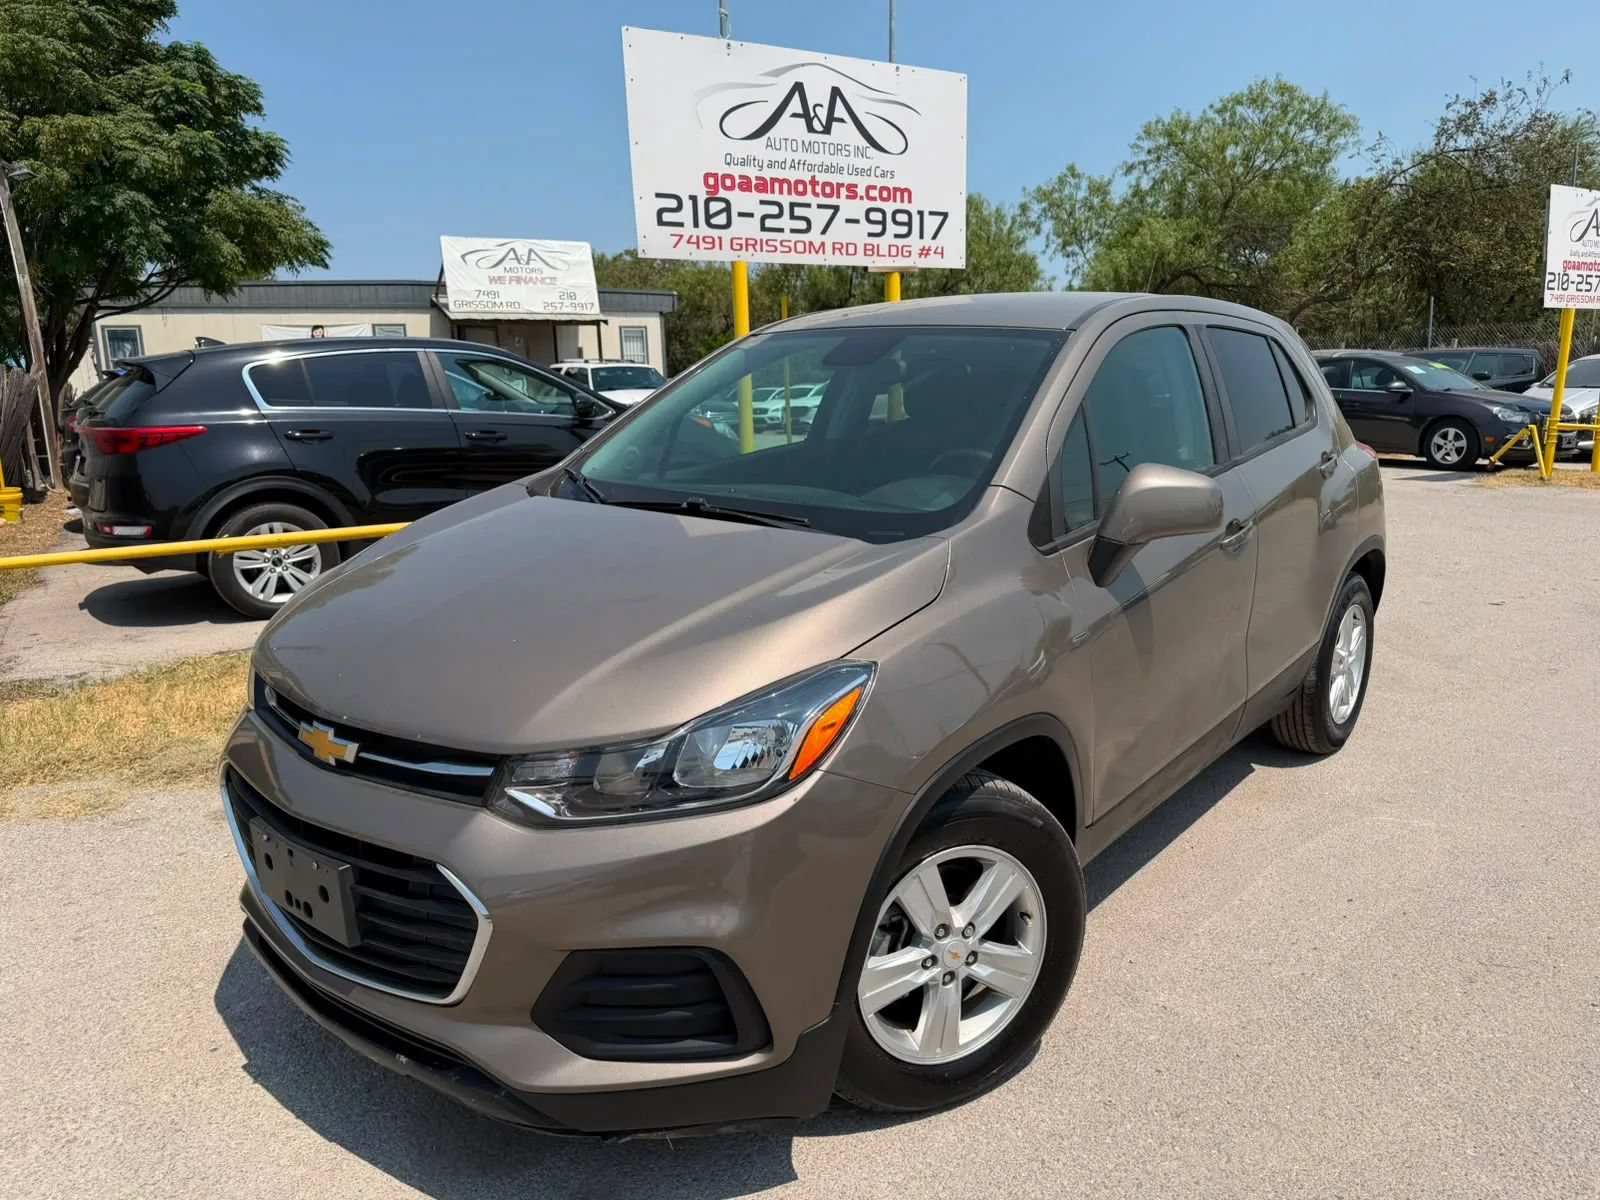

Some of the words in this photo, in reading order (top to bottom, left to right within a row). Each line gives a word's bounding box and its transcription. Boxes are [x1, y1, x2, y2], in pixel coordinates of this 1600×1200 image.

[719, 81, 909, 155] A&A
[765, 136, 799, 152] AUTO
[801, 140, 850, 157] MOTORS
[853, 145, 874, 160] INC.
[724, 152, 764, 171] Quality
[766, 157, 787, 171] and
[789, 159, 845, 175] Affordable
[847, 165, 872, 177] Used
[874, 166, 896, 179] Cars
[702, 171, 913, 204] goaamotors.com
[654, 192, 949, 240] 210-257-9917
[670, 233, 723, 251] 7491
[730, 236, 826, 255] GRISSOM
[832, 242, 857, 257] RD
[863, 243, 912, 258] BLDG
[918, 245, 945, 259] #4
[503, 266, 543, 275] MOTORS
[488, 275, 506, 285] WE
[508, 276, 558, 285] FINANCE
[475, 290, 500, 299] 7491
[559, 291, 577, 301] 210
[454, 300, 504, 309] GRISSOM
[505, 301, 520, 310] RD
[543, 302, 595, 312] 257-9917
